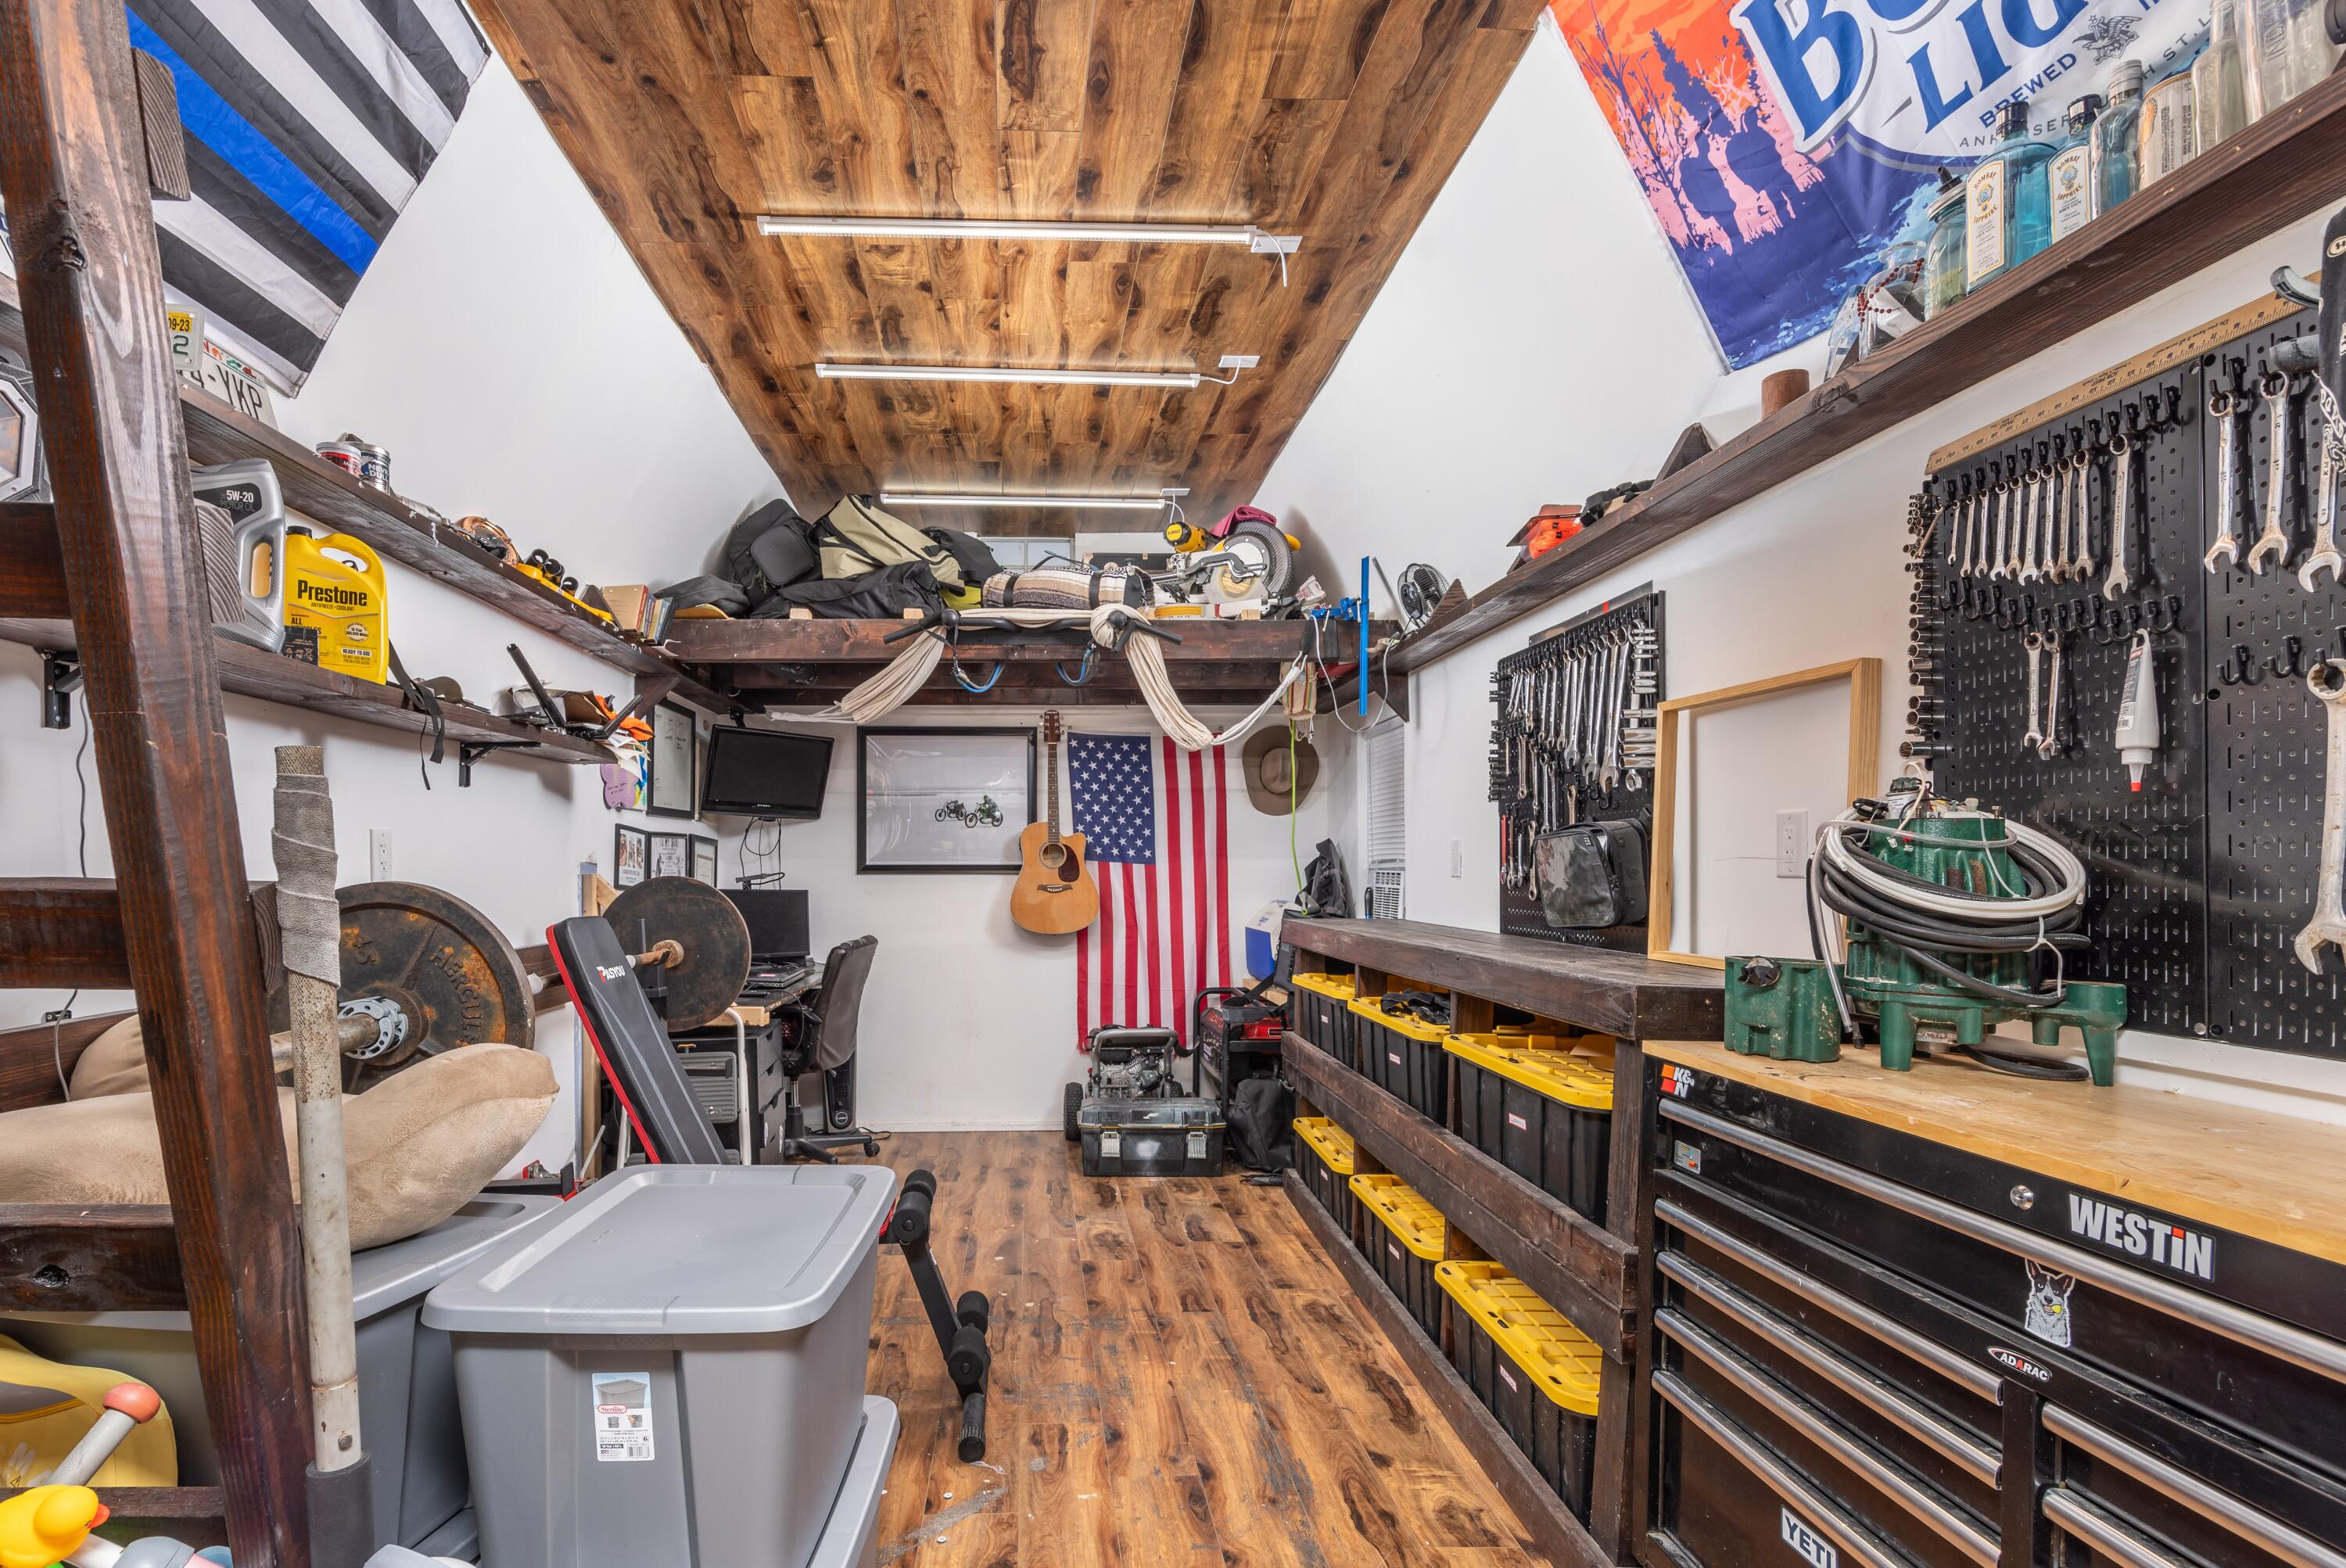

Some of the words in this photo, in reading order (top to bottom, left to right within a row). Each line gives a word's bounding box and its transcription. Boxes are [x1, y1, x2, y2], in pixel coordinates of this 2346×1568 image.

[2056, 156, 2080, 170] BOMBAY
[1974, 170, 1996, 189] BOMBAY
[2057, 183, 2083, 200] SAPPHIRE
[1972, 204, 1999, 224] SAPPHIRE
[2193, 328, 2206, 339] have
[2207, 322, 2219, 331] you
[2091, 376, 2107, 387] PREP
[2107, 371, 2118, 379] JOB
[226, 490, 254, 503] 5W-20
[221, 501, 244, 511] MOTOR
[245, 502, 256, 512] OIL
[297, 579, 368, 606] Prestone
[430, 945, 483, 1043] HERCULE
[2000, 1352, 2049, 1381] ADARAC
[1785, 1515, 1831, 1568] YETI
